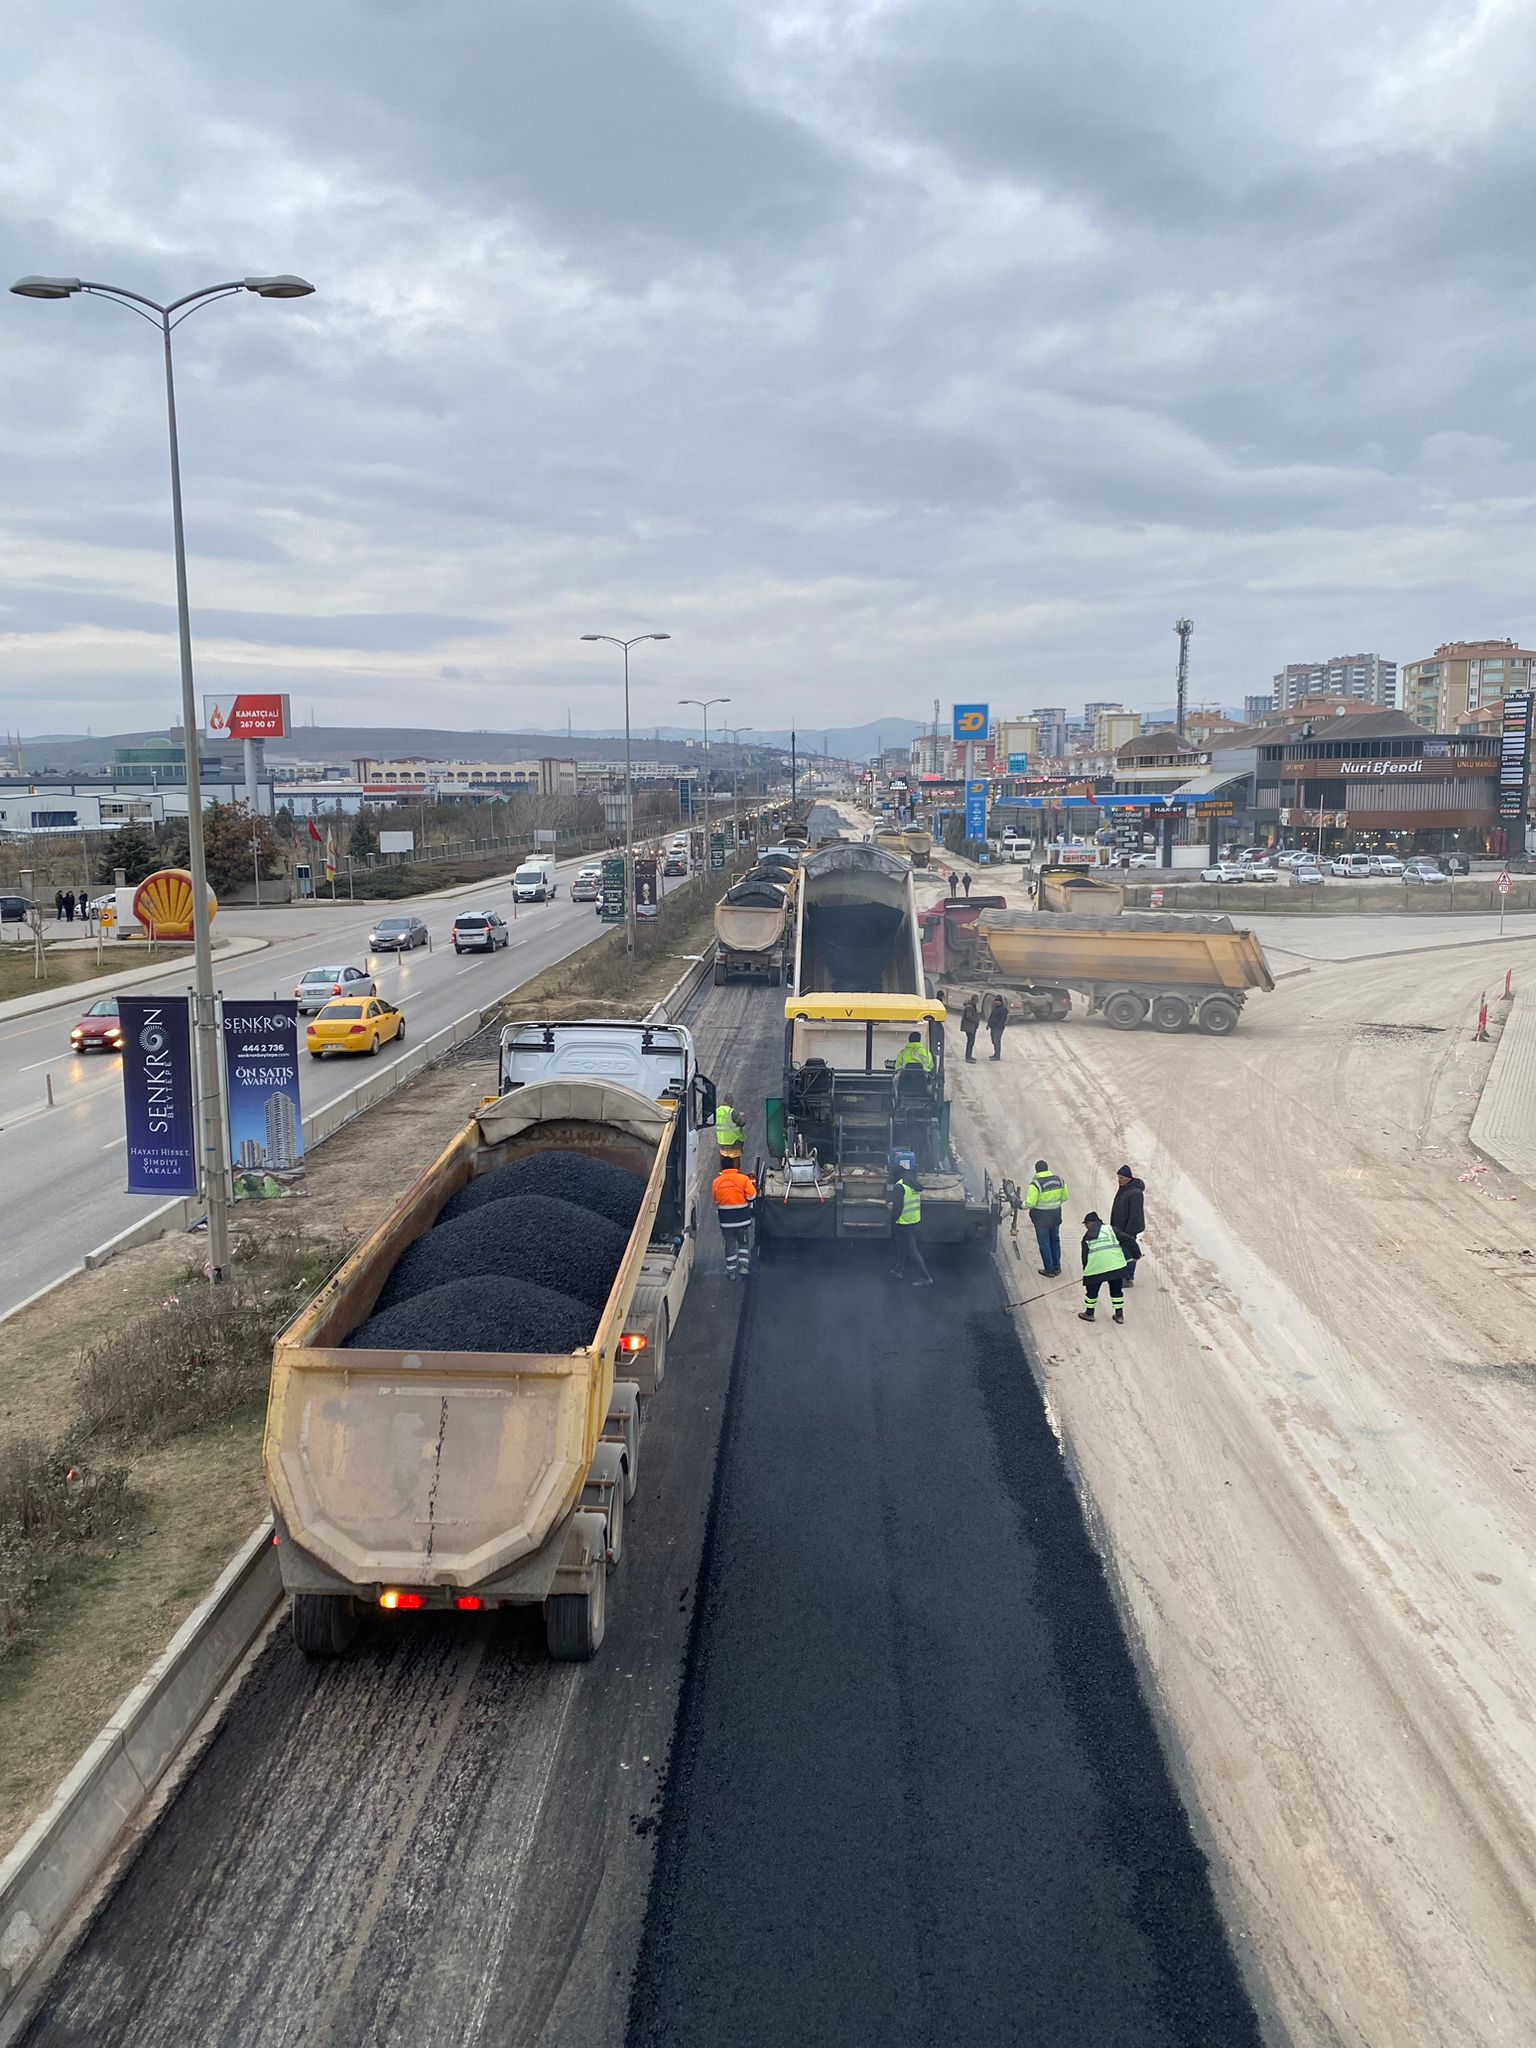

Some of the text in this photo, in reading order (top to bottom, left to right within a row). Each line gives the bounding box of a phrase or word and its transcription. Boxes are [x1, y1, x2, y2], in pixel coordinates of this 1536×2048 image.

[235, 710, 268, 719] KANATÇI
[240, 720, 275, 728] 267 00 67
[1373, 759, 1423, 776] Efendi
[224, 1014, 298, 1032] SENKRON
[241, 1044, 285, 1052] 444 2 736
[139, 1008, 169, 1133] SENKRON
[568, 1061, 629, 1072] FORD
[235, 1066, 294, 1079] ÖN SATIŞ
[241, 1077, 288, 1086] AVANTAJI
[164, 1061, 174, 1119] BEYTEPE
[143, 1166, 181, 1175] YAKALA!
